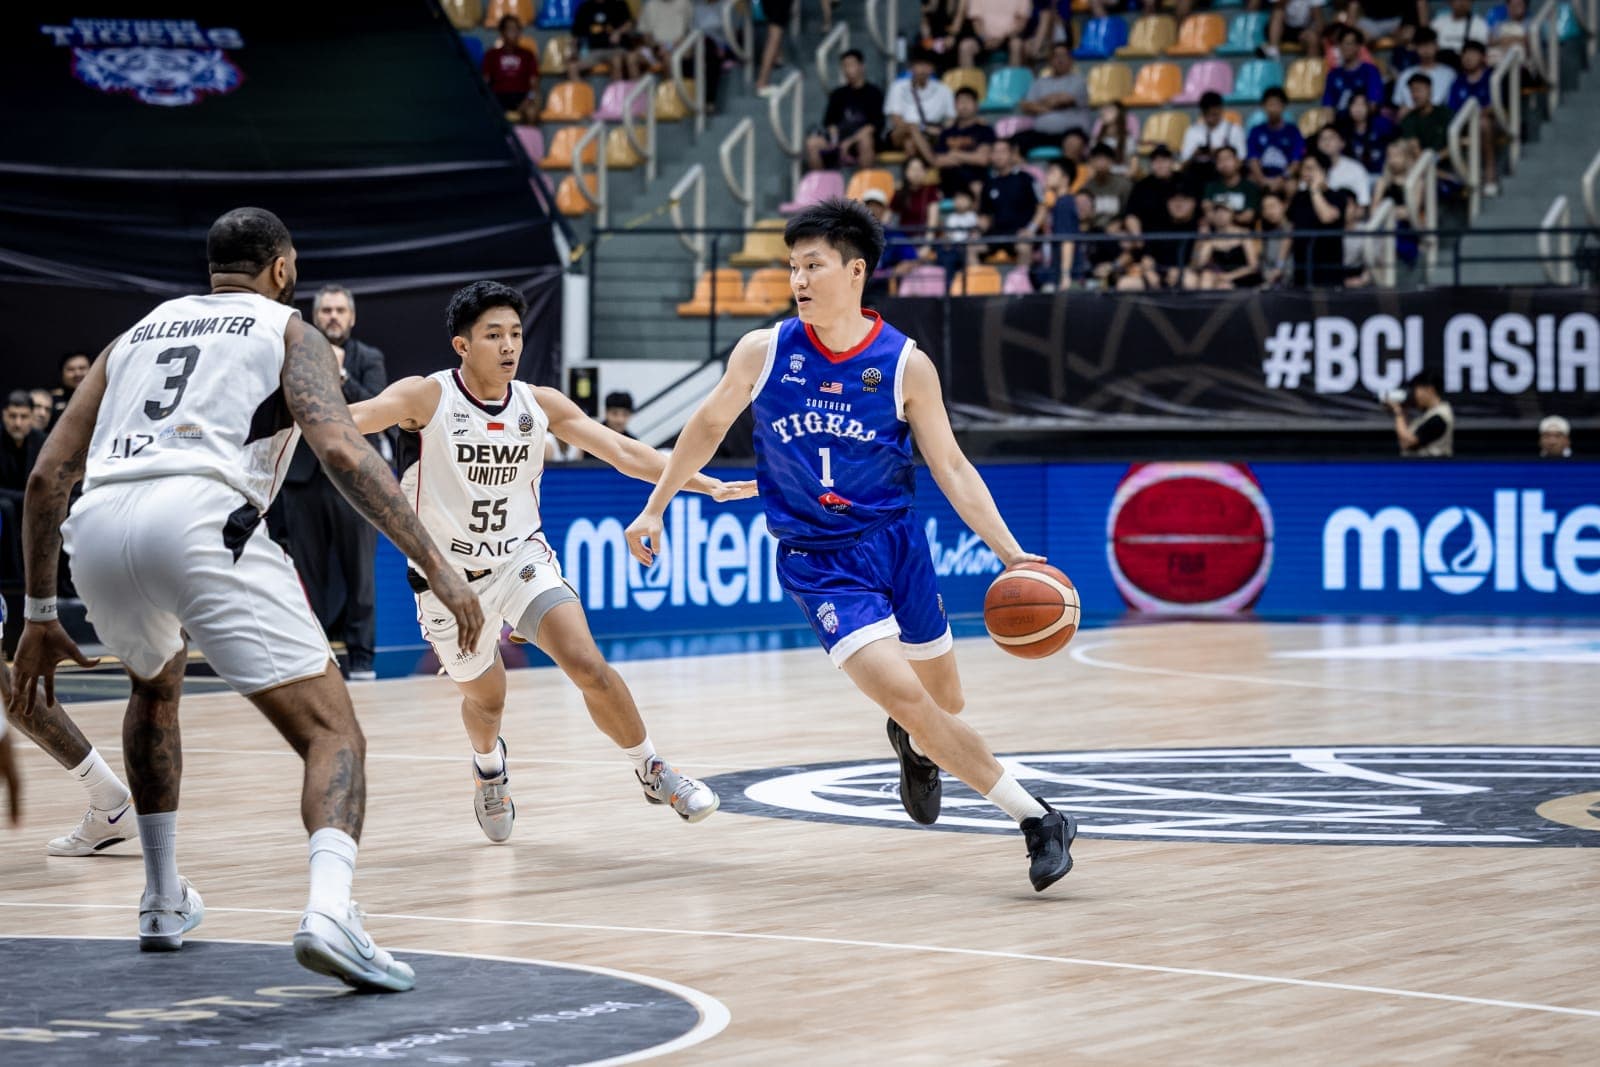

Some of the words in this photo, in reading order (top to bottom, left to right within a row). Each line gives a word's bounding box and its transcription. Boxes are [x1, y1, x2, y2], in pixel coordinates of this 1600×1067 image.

[130, 316, 256, 344] GILLENWATER
[143, 344, 201, 421] 3
[805, 398, 851, 413] SOUTHERN
[455, 443, 530, 464] DEWA
[818, 447, 835, 488] 1
[468, 466, 518, 486] UNITED
[468, 497, 509, 533] 55
